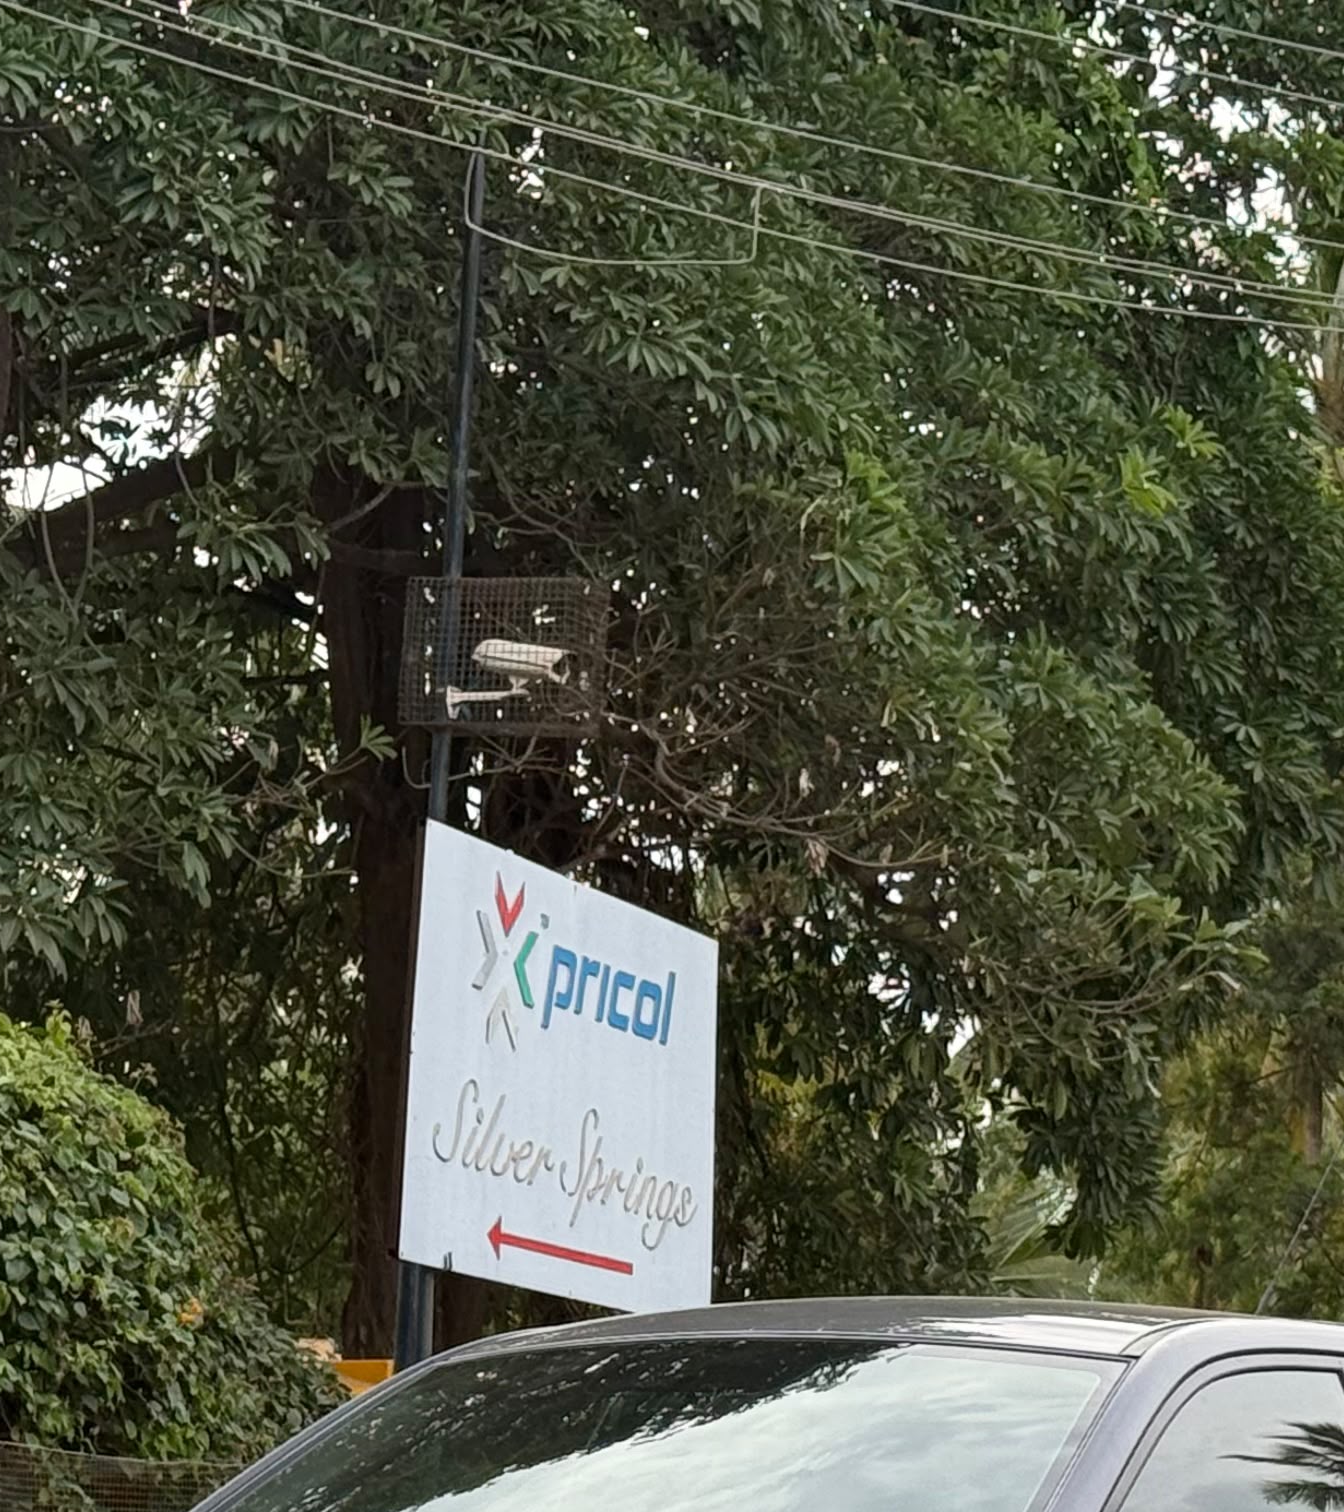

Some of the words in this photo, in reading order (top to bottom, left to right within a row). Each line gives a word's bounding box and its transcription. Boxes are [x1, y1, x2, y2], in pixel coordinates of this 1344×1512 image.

[541, 944, 676, 1046] pricol
[432, 1078, 555, 1187] Silver
[559, 1107, 699, 1251] Springs
